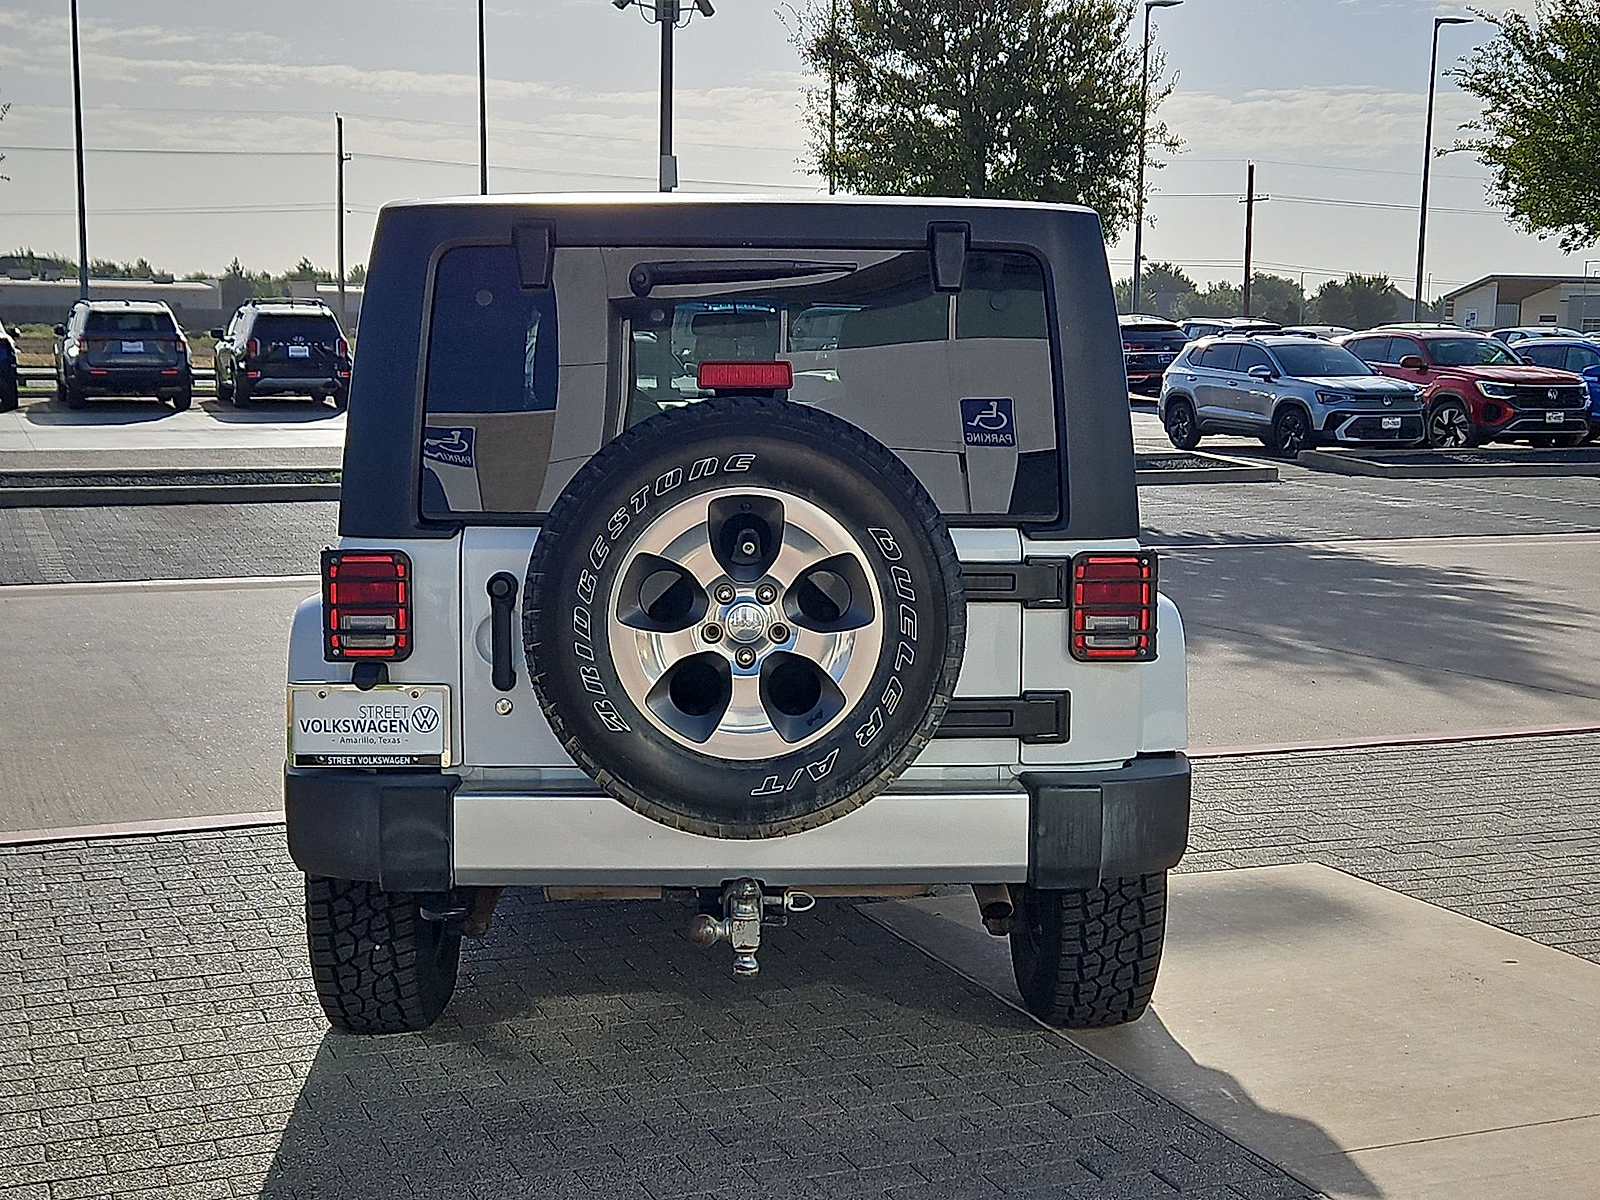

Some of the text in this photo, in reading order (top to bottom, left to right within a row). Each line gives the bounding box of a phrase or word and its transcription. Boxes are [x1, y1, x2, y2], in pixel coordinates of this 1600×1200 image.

[573, 453, 756, 732] BRIDGESTONE
[855, 527, 918, 747] DUELER
[358, 705, 410, 719] STREET
[299, 719, 410, 734] VOLKSWAGEN
[339, 736, 401, 746] Amarillo, Texas
[327, 756, 411, 765] STREET VOLKSWAGEN
